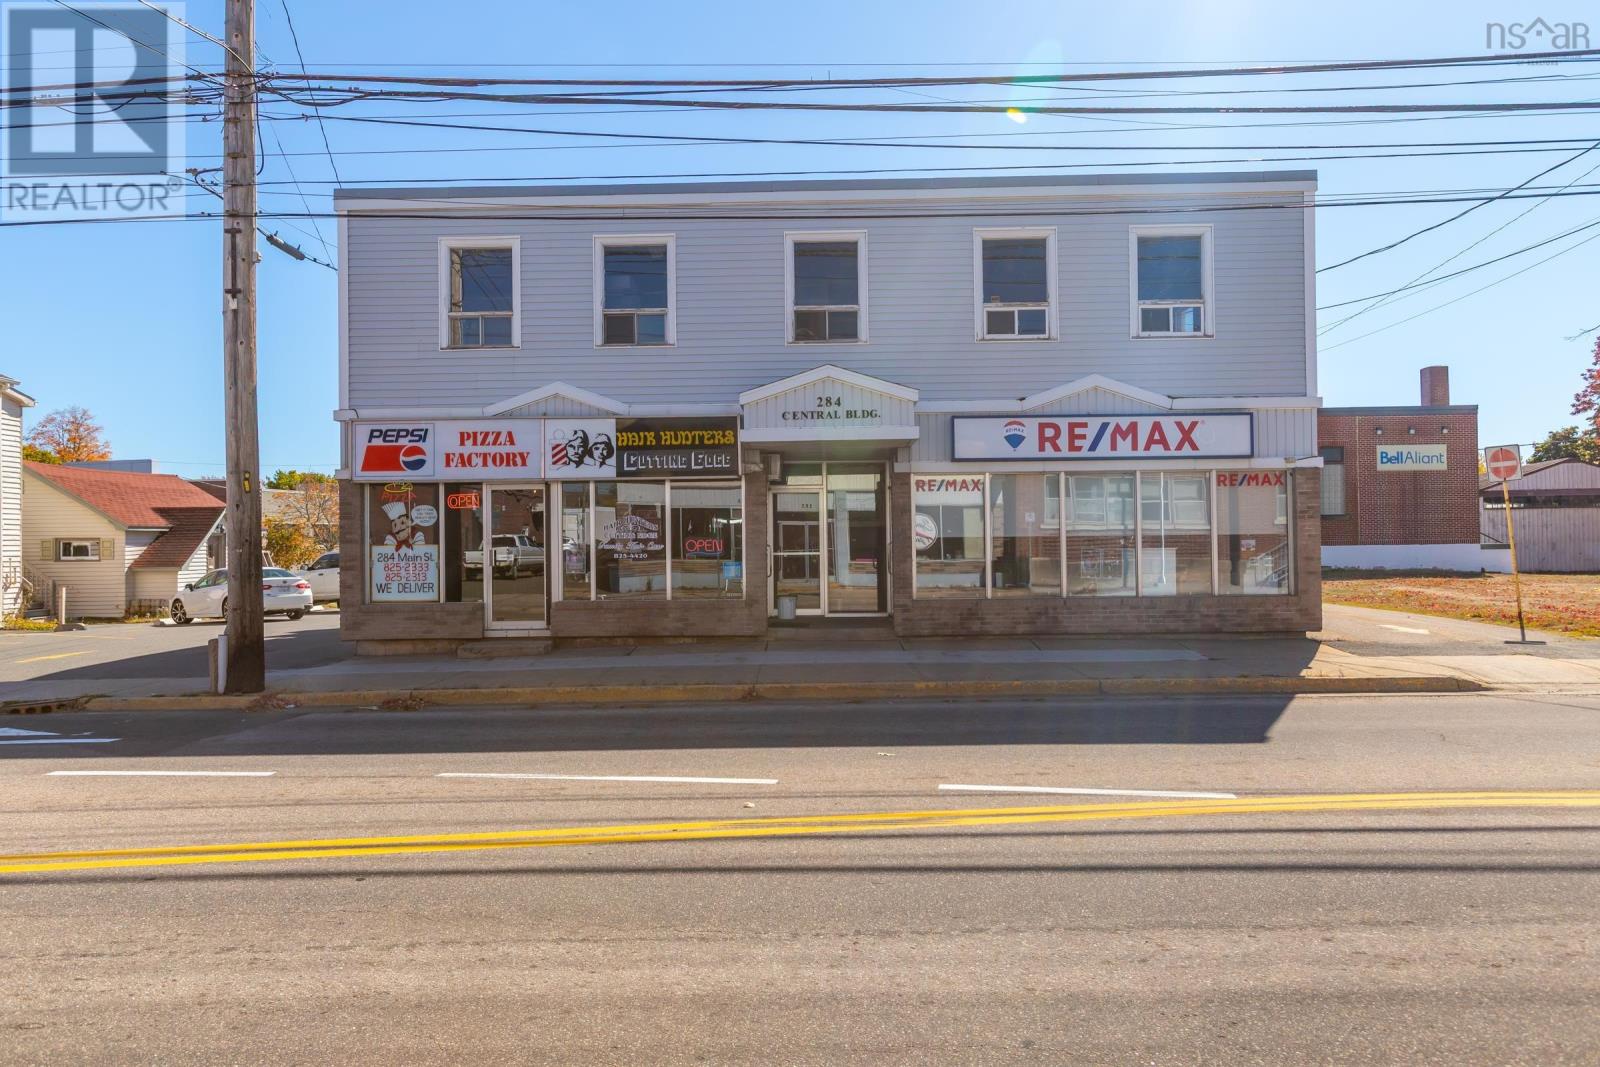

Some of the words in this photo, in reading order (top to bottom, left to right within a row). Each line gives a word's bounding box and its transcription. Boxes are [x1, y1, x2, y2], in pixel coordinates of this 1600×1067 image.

[816, 396, 842, 408] 284
[782, 410, 841, 421] CENTRAL
[845, 409, 881, 419] BLDG.
[367, 428, 429, 443] PEPSI
[459, 431, 516, 447] PIZZA
[617, 431, 656, 447] HAIR
[660, 430, 735, 446] HUNTERS
[1037, 420, 1200, 453] RE/MAX
[444, 452, 530, 468] FACTORY
[915, 478, 982, 493] RE/MAX
[1217, 472, 1285, 487] RE/MAX
[449, 494, 480, 507] OPEN
[685, 539, 724, 552] OPEN
[377, 552, 395, 562] 284
[397, 552, 422, 562] Main
[384, 562, 429, 572] 825-2333
[376, 582, 393, 593] WE
[397, 582, 435, 593] DELIVER
